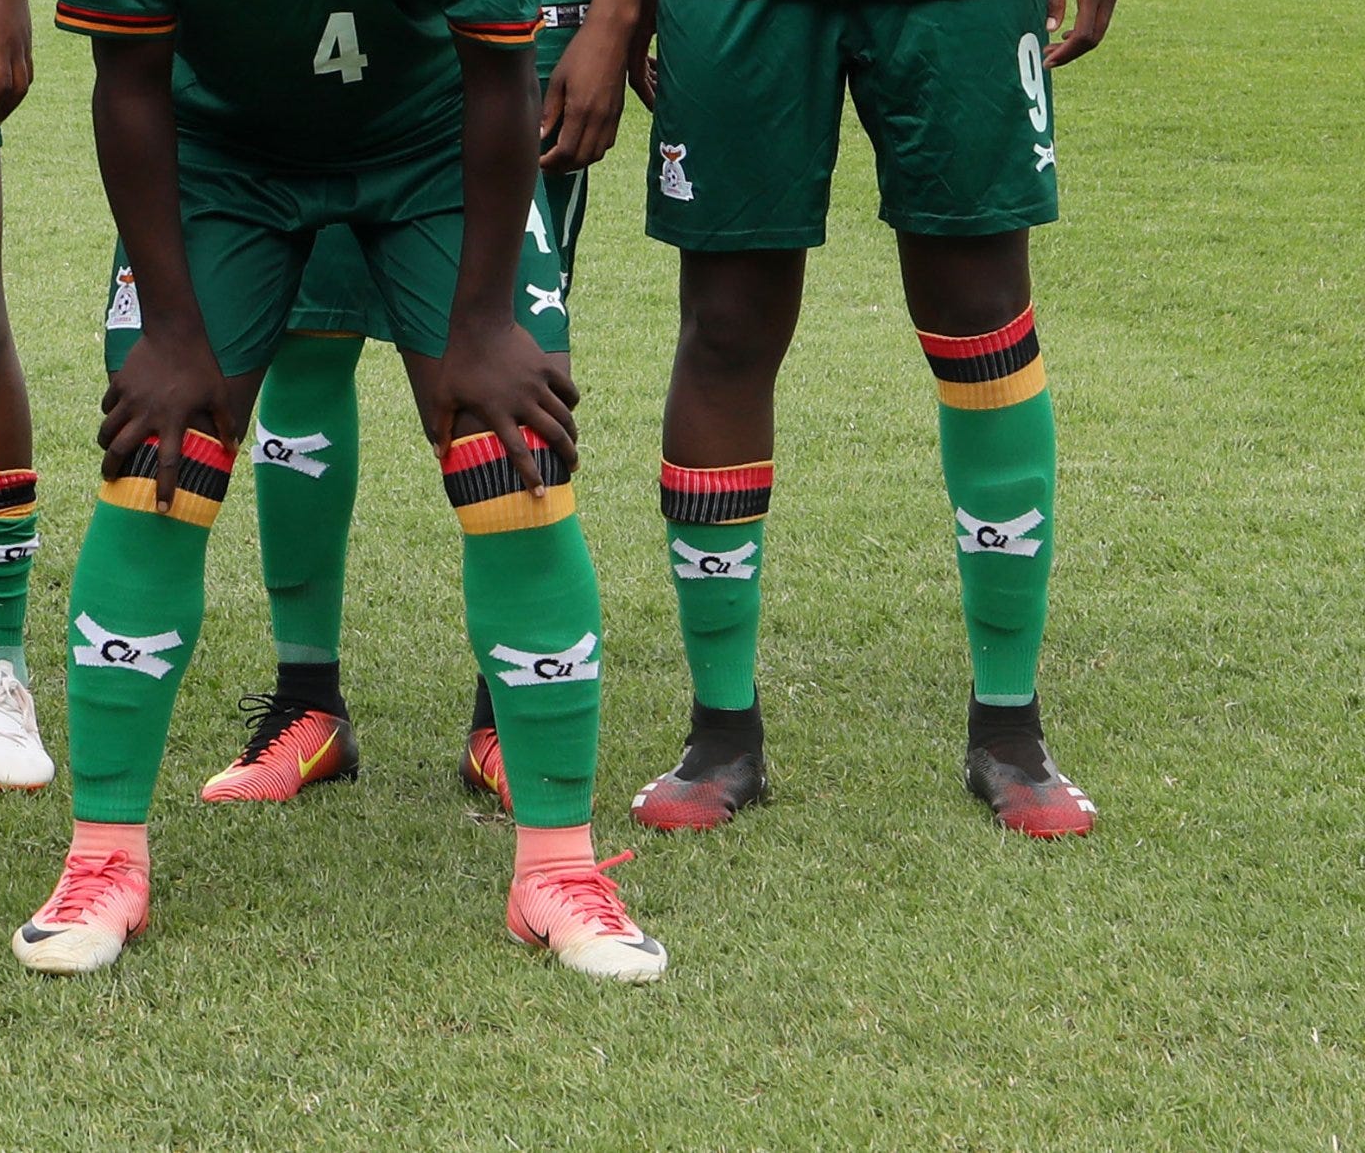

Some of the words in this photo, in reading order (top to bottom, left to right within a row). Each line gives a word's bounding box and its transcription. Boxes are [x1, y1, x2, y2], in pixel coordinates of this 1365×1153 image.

[313, 11, 368, 84] 4
[1017, 32, 1047, 133] 9
[263, 439, 293, 463] Cu
[977, 525, 1008, 548] Cu
[699, 556, 731, 575] Cu
[101, 639, 140, 664] Cu
[533, 658, 573, 679] Cu
